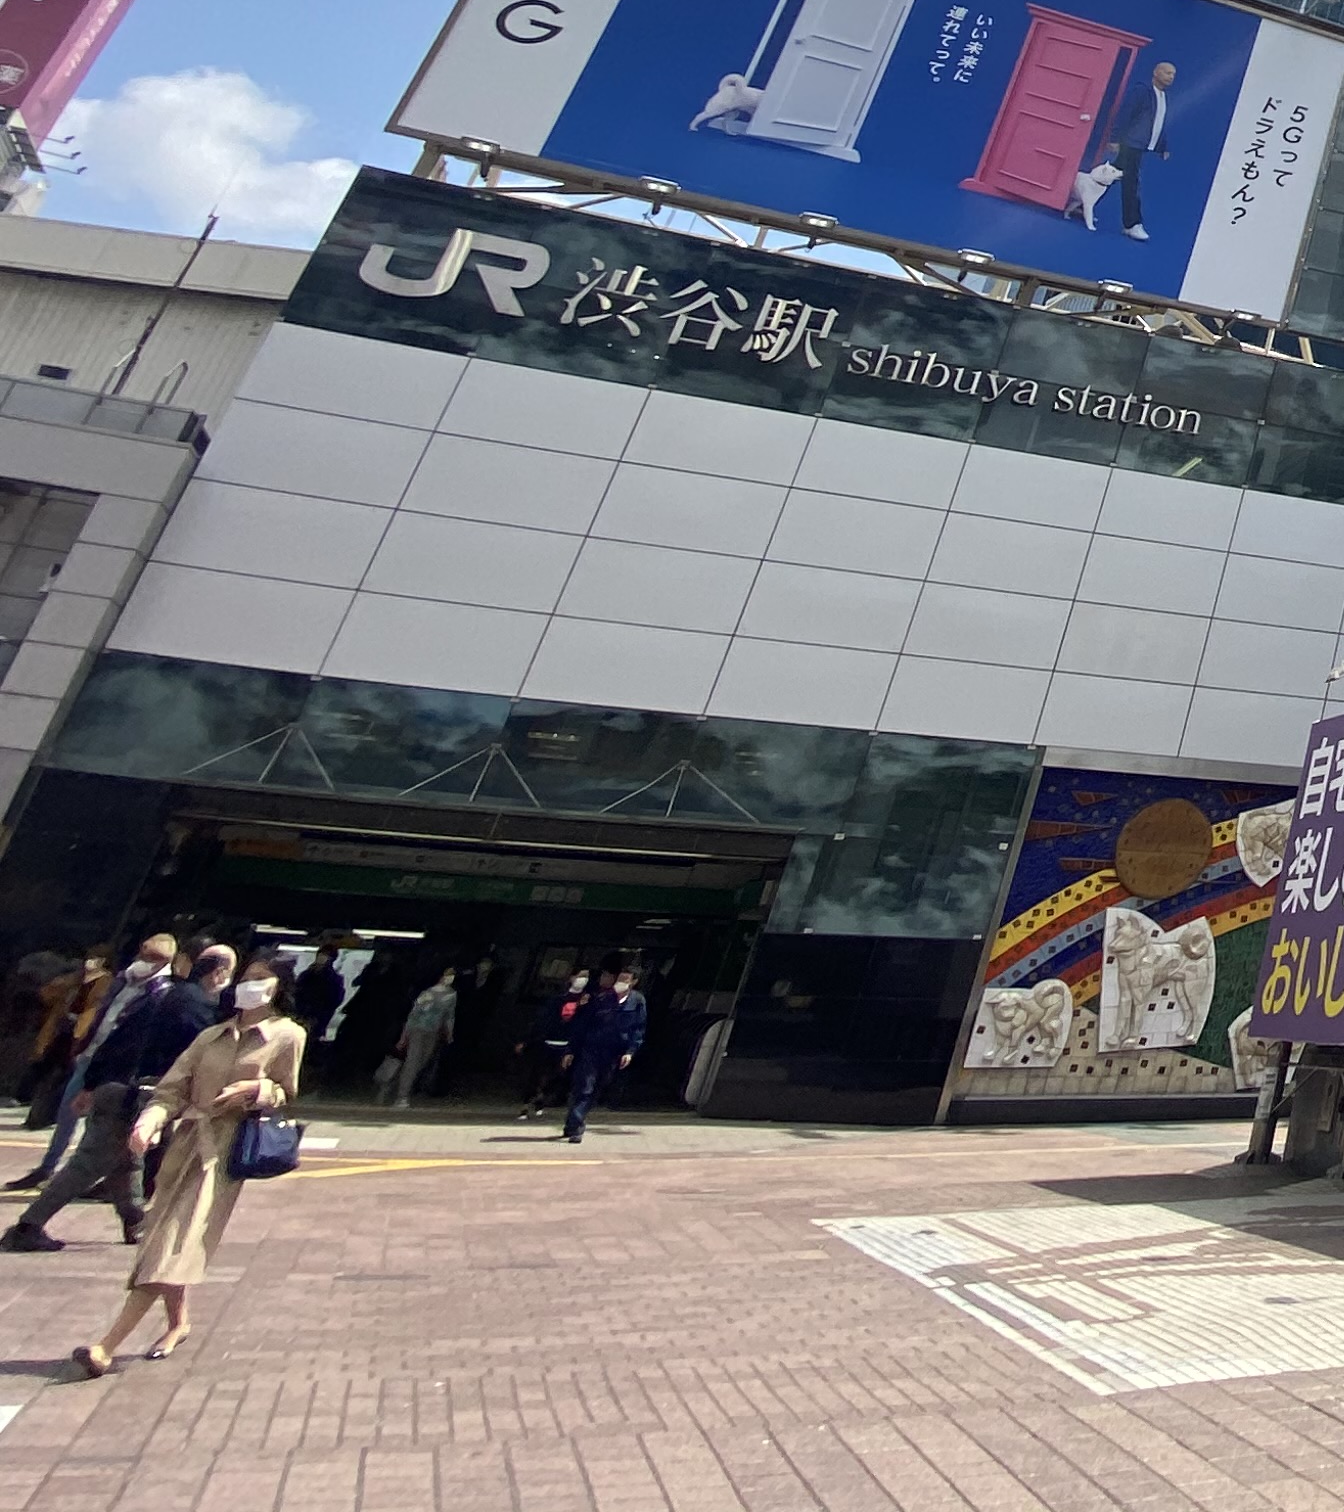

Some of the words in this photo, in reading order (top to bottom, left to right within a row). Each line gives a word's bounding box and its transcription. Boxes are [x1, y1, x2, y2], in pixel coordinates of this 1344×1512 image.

[954, 14, 993, 83] いい未来に
[1272, 105, 1309, 188] 5Gって
[359, 227, 550, 318] JR
[559, 255, 839, 370] 渋谷駅
[846, 343, 1039, 407] shibuya
[1053, 384, 1202, 436] station
